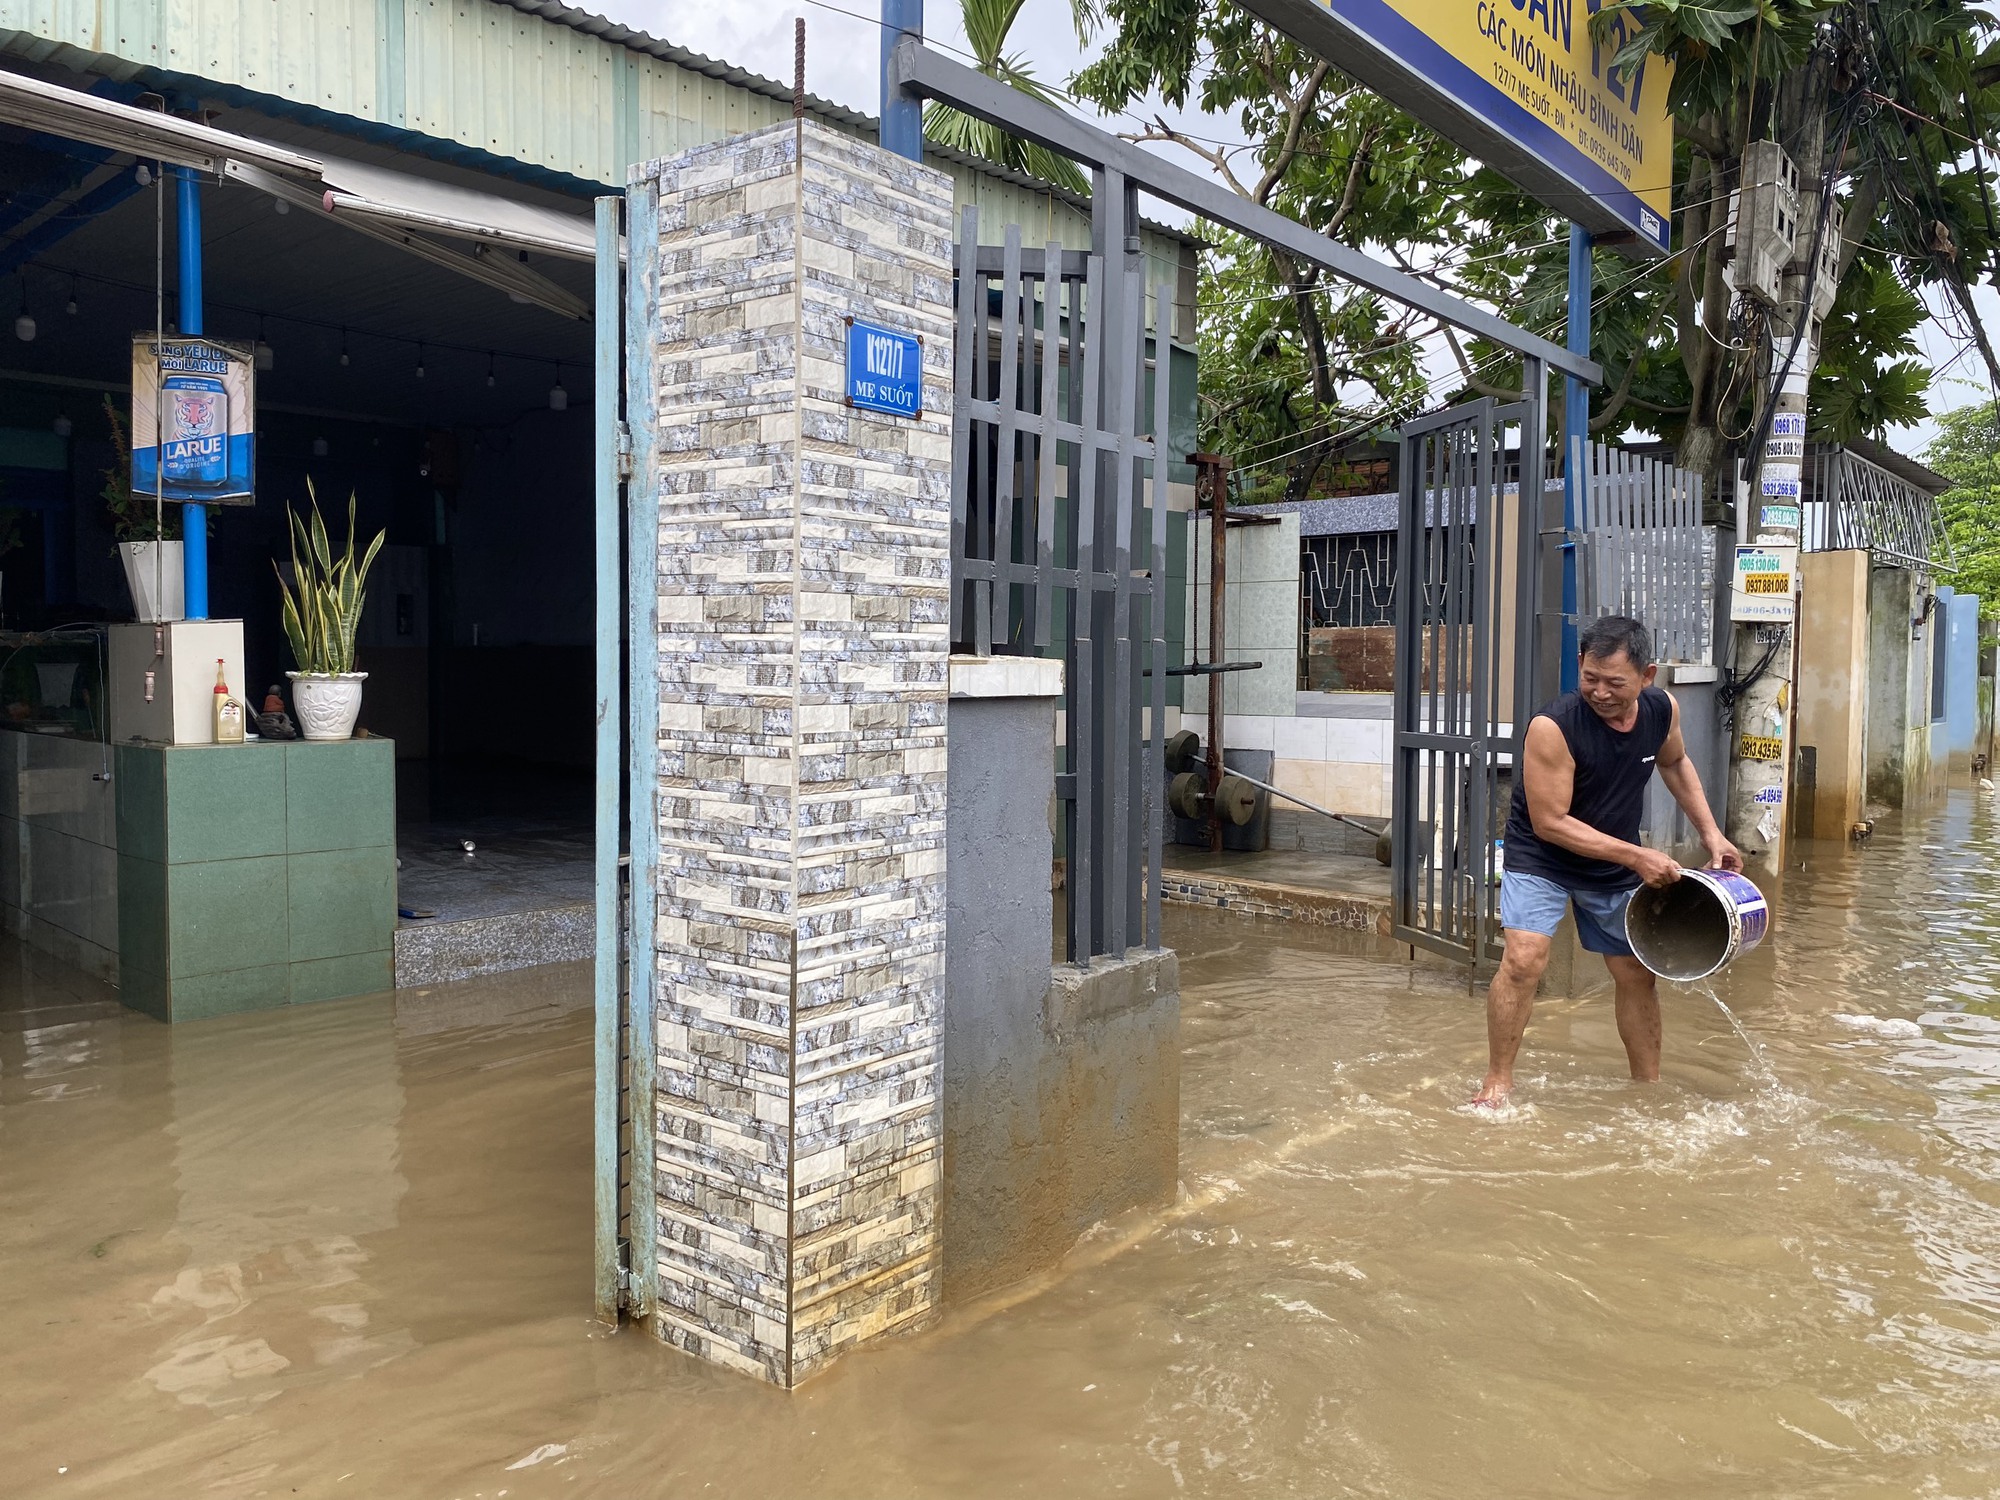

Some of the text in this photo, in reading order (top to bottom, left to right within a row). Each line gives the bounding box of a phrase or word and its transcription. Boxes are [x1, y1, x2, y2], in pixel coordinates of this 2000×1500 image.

[1477, 1, 1643, 165] CÁC MÓN NHẬU BÌNH DÂN
[1493, 61, 1516, 92] 127/7
[1518, 80, 1530, 108] MẸ
[1531, 91, 1550, 118] SUỐT
[1555, 108, 1566, 130] ĐN
[1590, 137, 1606, 162] 0935
[1607, 151, 1619, 173] 645
[1620, 161, 1632, 183] 709
[184, 358, 227, 374] LARUE
[867, 332, 904, 379] K127/7
[855, 380, 914, 407] MẸ SUỐT
[166, 436, 222, 460] LARUE
[1739, 558, 1780, 571] 0905.130.064
[1746, 579, 1788, 593] 0937.881.008
